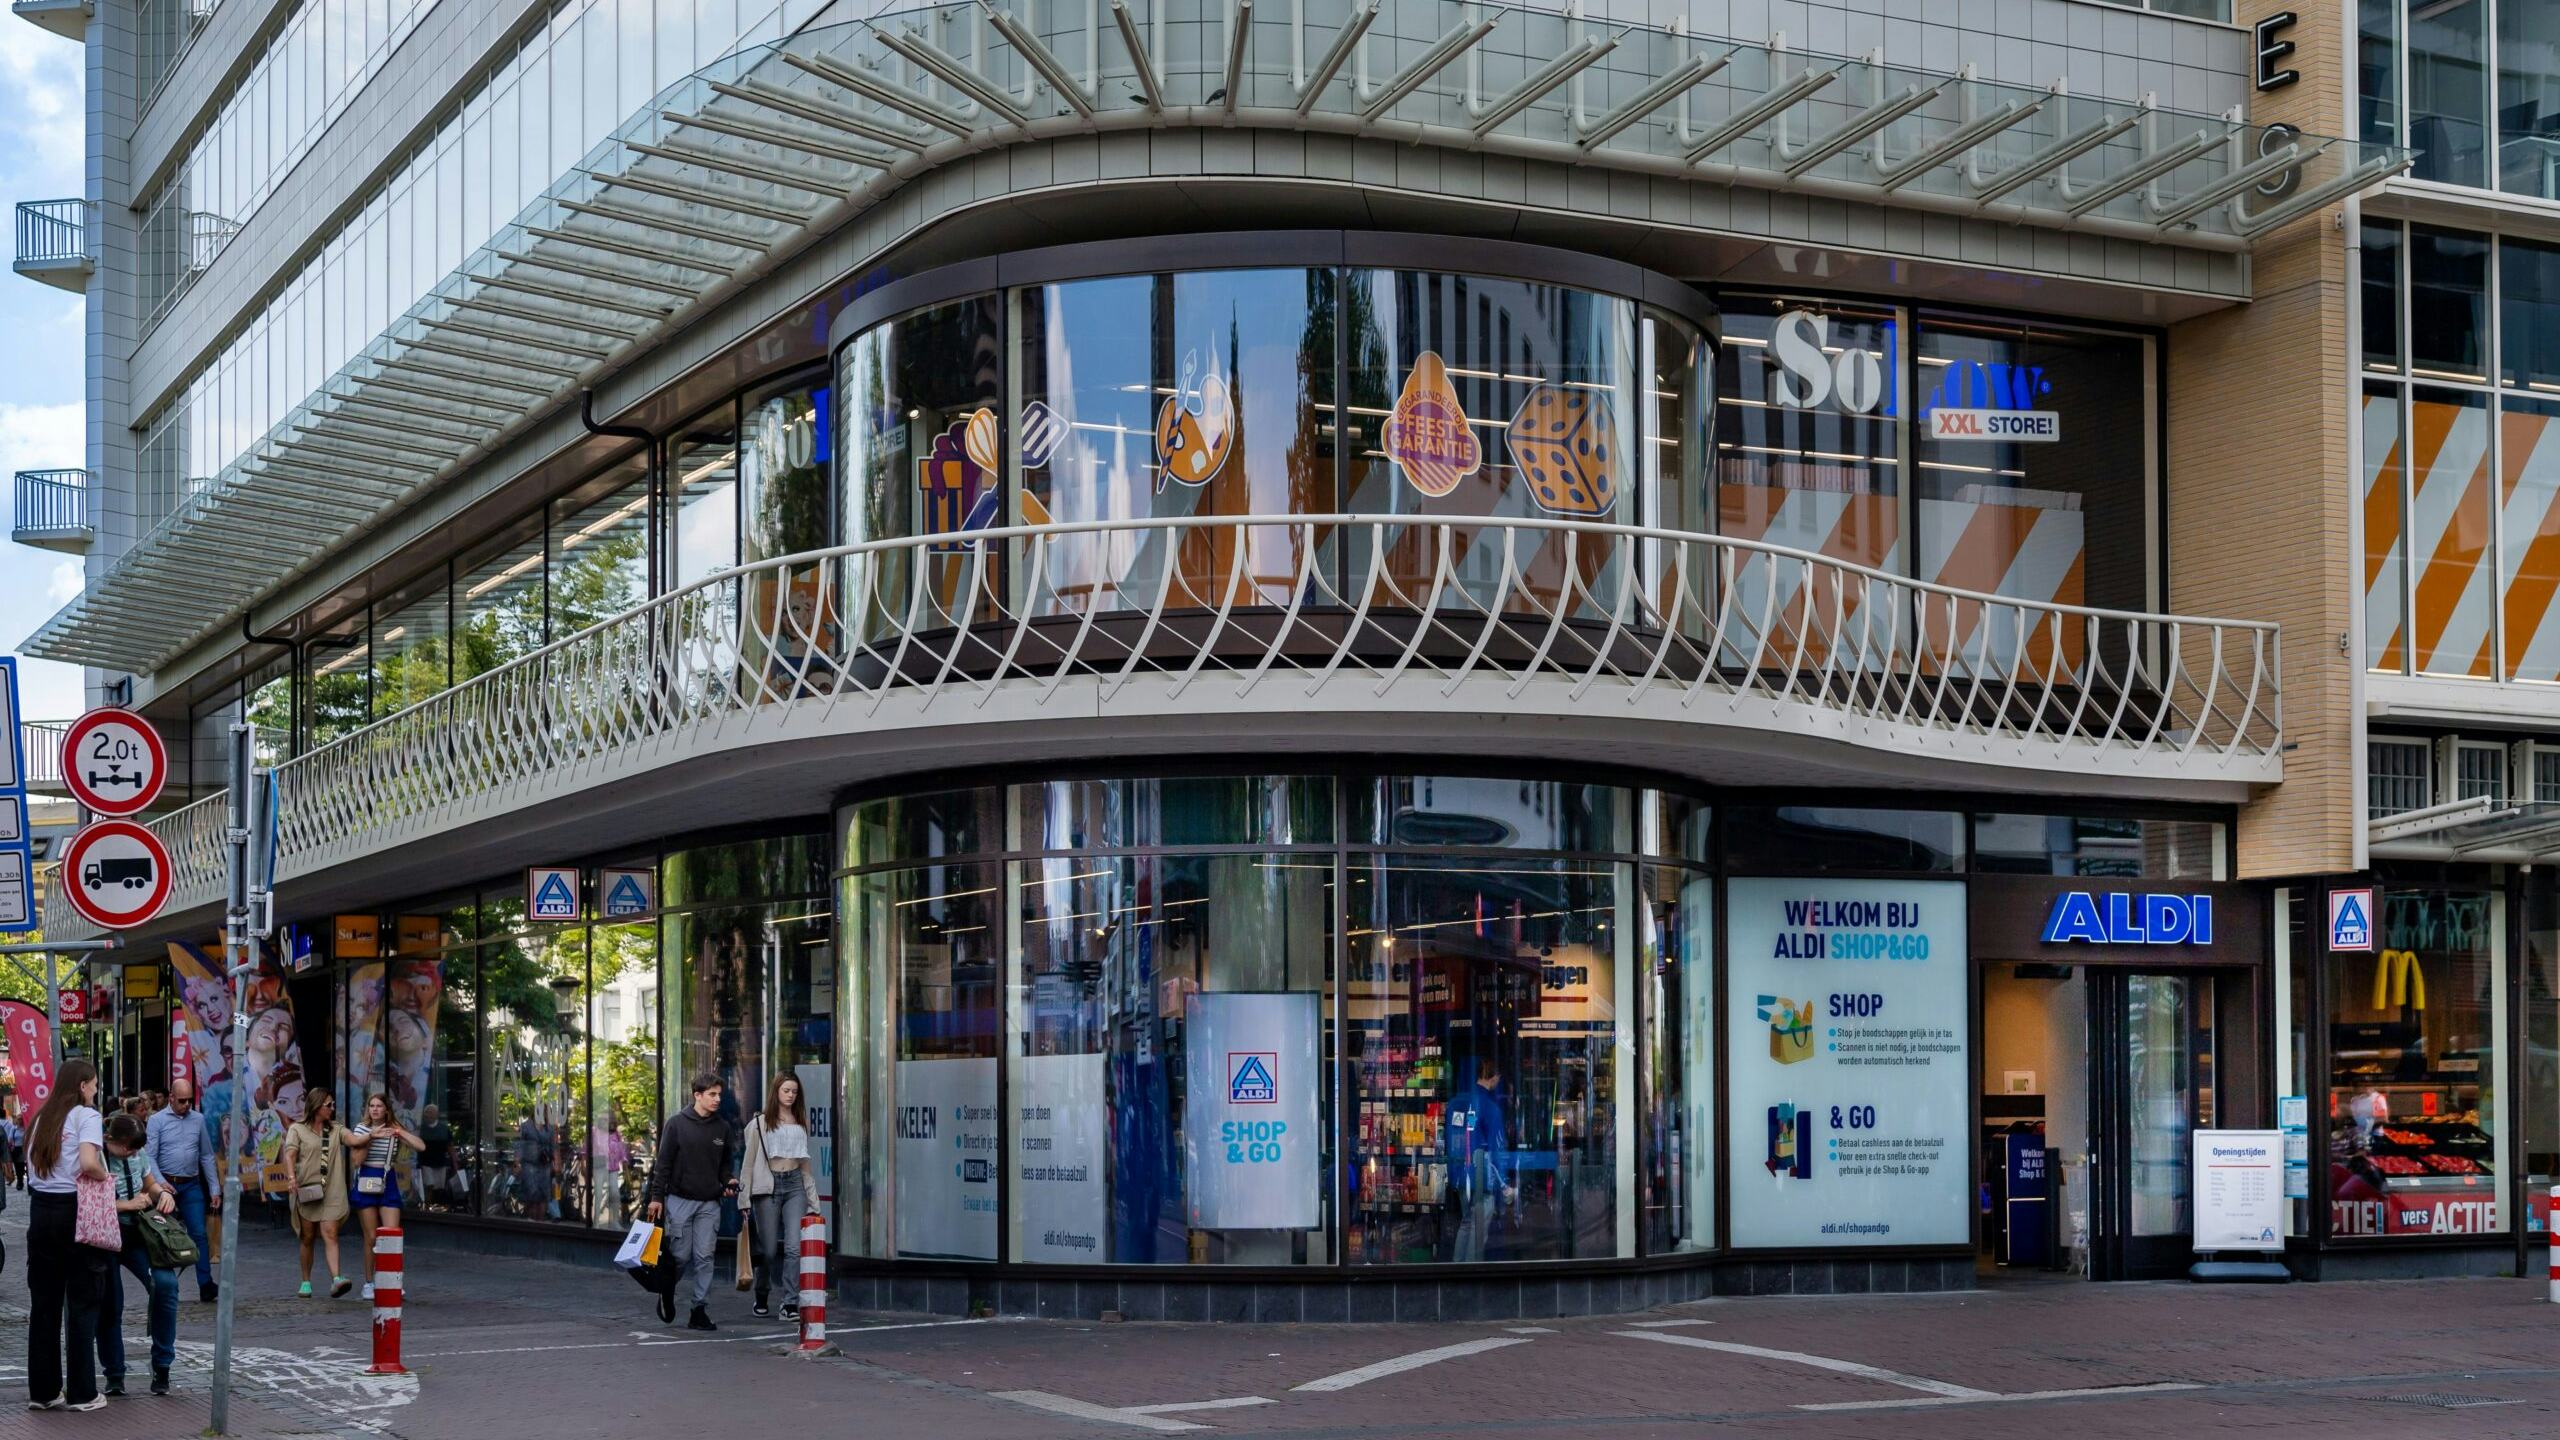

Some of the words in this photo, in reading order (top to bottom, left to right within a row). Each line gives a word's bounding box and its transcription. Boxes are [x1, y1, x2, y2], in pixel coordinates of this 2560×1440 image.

[1405, 415, 1456, 439] FEEST
[1938, 413, 1982, 434] XXL
[1988, 416, 2053, 435] STORE!
[1390, 431, 1473, 460] GARANTIE
[540, 905, 570, 913] ALDI
[1784, 901, 1880, 927] WELKOM
[1887, 902, 1919, 928] BIJ
[2041, 892, 2213, 944] ALDI
[2338, 932, 2365, 944] ALDI
[1774, 933, 1824, 959] ALDI
[1831, 933, 1929, 960] SHOP&GO
[1829, 994, 1883, 1017] SHOP
[1837, 1028, 1852, 1039] Stop
[1854, 1028, 1860, 1039] je
[1862, 1028, 1907, 1039] boodschappen
[1909, 1029, 1927, 1039] gelijk
[1928, 1029, 1935, 1037] in
[1935, 1029, 1942, 1039] je
[1943, 1029, 1952, 1037] tas
[1837, 1043, 1866, 1052] Scannen
[1868, 1043, 1874, 1051] is
[1875, 1043, 1888, 1052] niet
[1890, 1043, 1908, 1054] nodig,
[1910, 1044, 1916, 1053] je
[1918, 1044, 1961, 1053] boodschappen
[1838, 1057, 1862, 1065] worden
[1864, 1057, 1904, 1065] automatisch
[1905, 1057, 1930, 1065] herkend
[1237, 1089, 1270, 1099] ALDI
[964, 1105, 979, 1122] Super
[980, 1106, 992, 1120] snel
[1036, 1105, 1051, 1120] doen
[1830, 1106, 1843, 1129] &
[1850, 1106, 1875, 1129] GO
[810, 1107, 831, 1137] BEL
[1221, 1121, 1287, 1142] SHOP
[964, 1134, 979, 1149] Direct
[1027, 1138, 1051, 1150] scannen
[1839, 1138, 1859, 1147] Betaal
[1862, 1138, 1890, 1147] cashless
[1905, 1138, 1912, 1147] de
[1914, 1138, 1944, 1147] betaalzuil
[1226, 1143, 1244, 1163] &
[1249, 1143, 1281, 1163] GO
[1839, 1152, 1852, 1160] Voor
[1887, 1152, 1906, 1160] snelle
[1908, 1152, 1939, 1160] check-out
[2212, 1147, 2266, 1158] Openingstijden
[1035, 1168, 1046, 1180] aan
[1048, 1165, 1055, 1180] de
[1057, 1165, 1087, 1181] betaalzuil
[1839, 1166, 1863, 1177] gebruik
[1865, 1166, 1871, 1176] je
[1873, 1166, 1881, 1174] de
[1883, 1165, 1898, 1176] Shop
[1900, 1165, 1905, 1174] &
[1907, 1165, 1929, 1175] Go-app
[2402, 1210, 2428, 1225] vers
[2431, 1202, 2496, 1233] ACTIE
[1821, 1223, 1890, 1235] aldi.nl/shopandgo
[1044, 1230, 1096, 1252] aldi.nl/shopandgo
